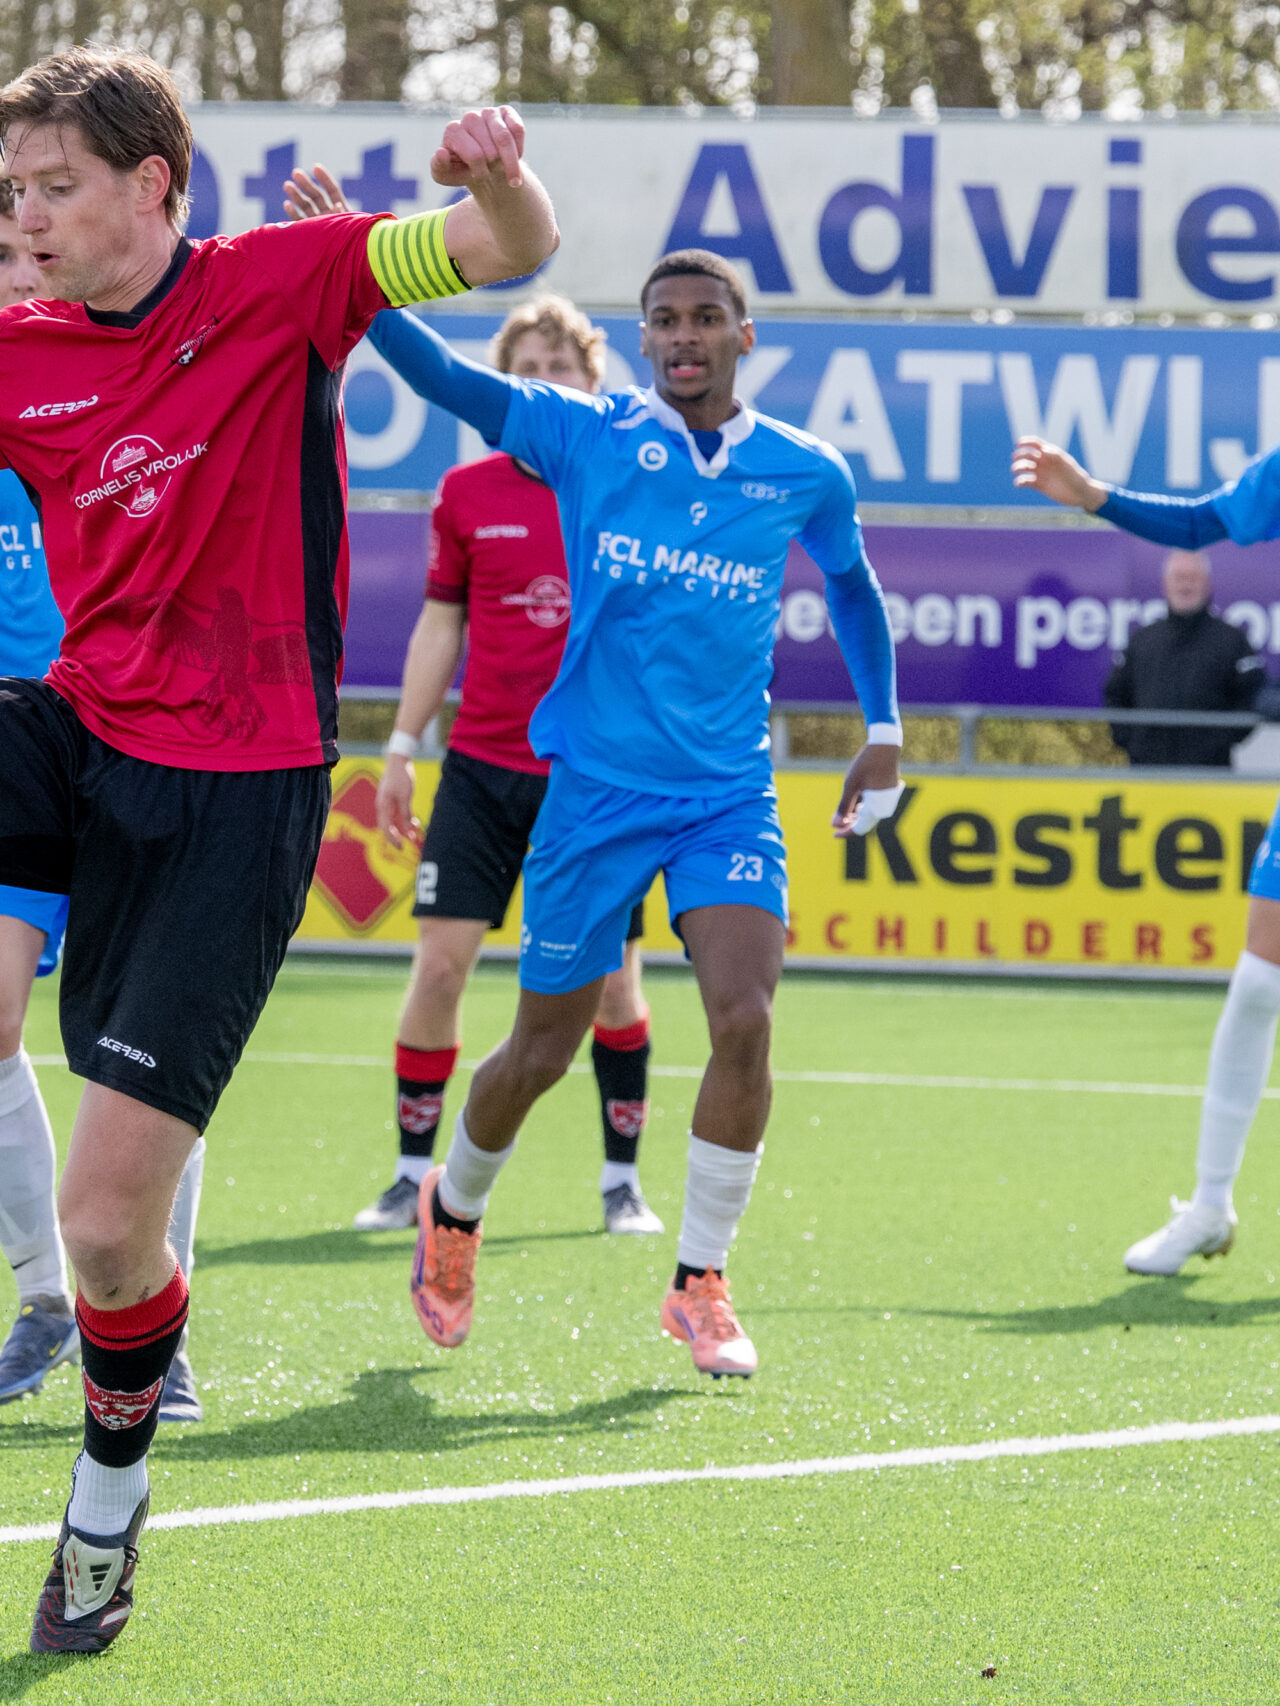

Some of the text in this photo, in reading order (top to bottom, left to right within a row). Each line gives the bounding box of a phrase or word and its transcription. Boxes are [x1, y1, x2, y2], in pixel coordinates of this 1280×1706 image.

[74, 470, 141, 509] CORNELIS
[597, 531, 647, 567] FCL
[726, 853, 764, 882] 23
